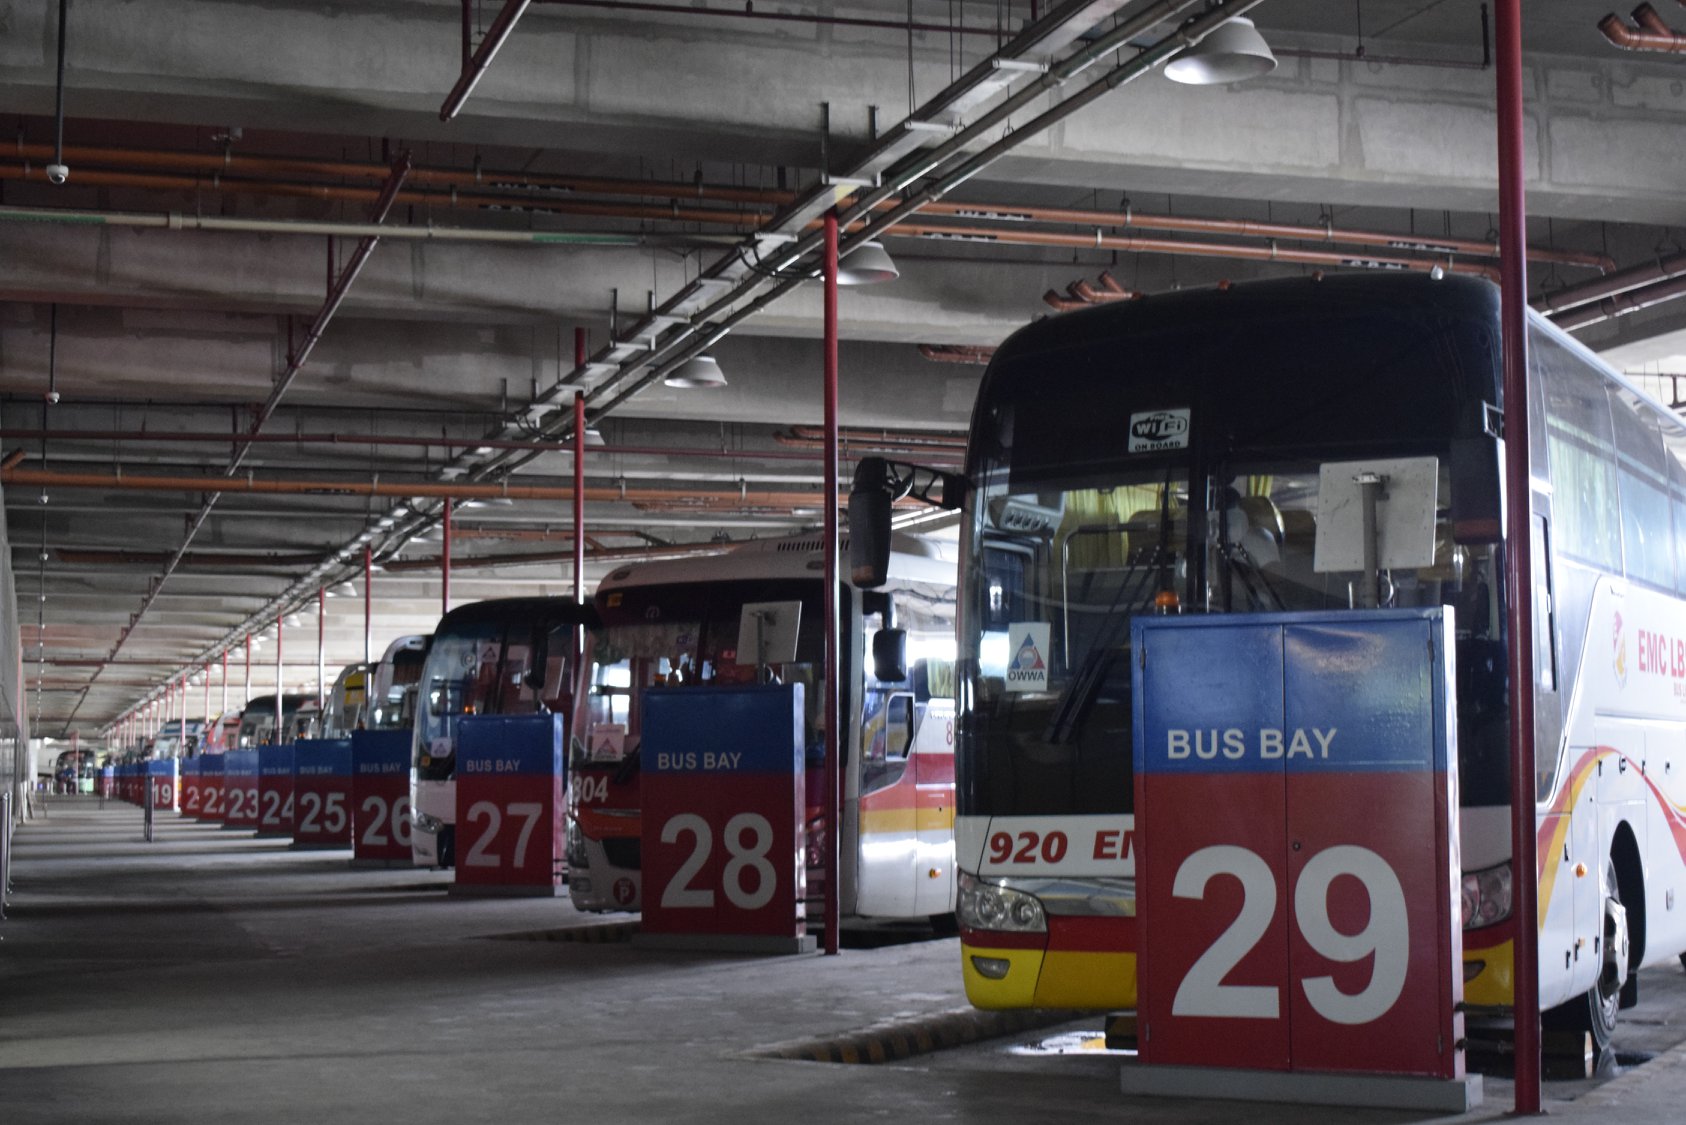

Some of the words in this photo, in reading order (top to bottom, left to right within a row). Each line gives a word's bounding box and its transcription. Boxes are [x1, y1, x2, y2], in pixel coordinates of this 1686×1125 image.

[1135, 443, 1148, 451] ON
[1150, 441, 1181, 450] BOARD
[1638, 629, 1667, 676] EMC
[1670, 637, 1686, 679] LB
[1008, 670, 1045, 682] OWWA
[1167, 729, 1246, 760] BUS
[1259, 727, 1339, 760] BAY
[360, 763, 379, 773] BUS
[382, 762, 401, 773] BAY
[466, 760, 492, 773] BUS
[496, 760, 521, 772] BAY
[657, 752, 697, 770] BUS
[703, 752, 742, 770] BAY
[229, 788, 258, 819] 23
[571, 775, 609, 803] 804
[262, 790, 295, 825] 24
[300, 792, 346, 833] 25
[362, 796, 412, 846] 26
[465, 801, 543, 868] 27
[988, 831, 1068, 864] 920
[661, 812, 777, 910] 28
[1171, 844, 1410, 1025] 29
